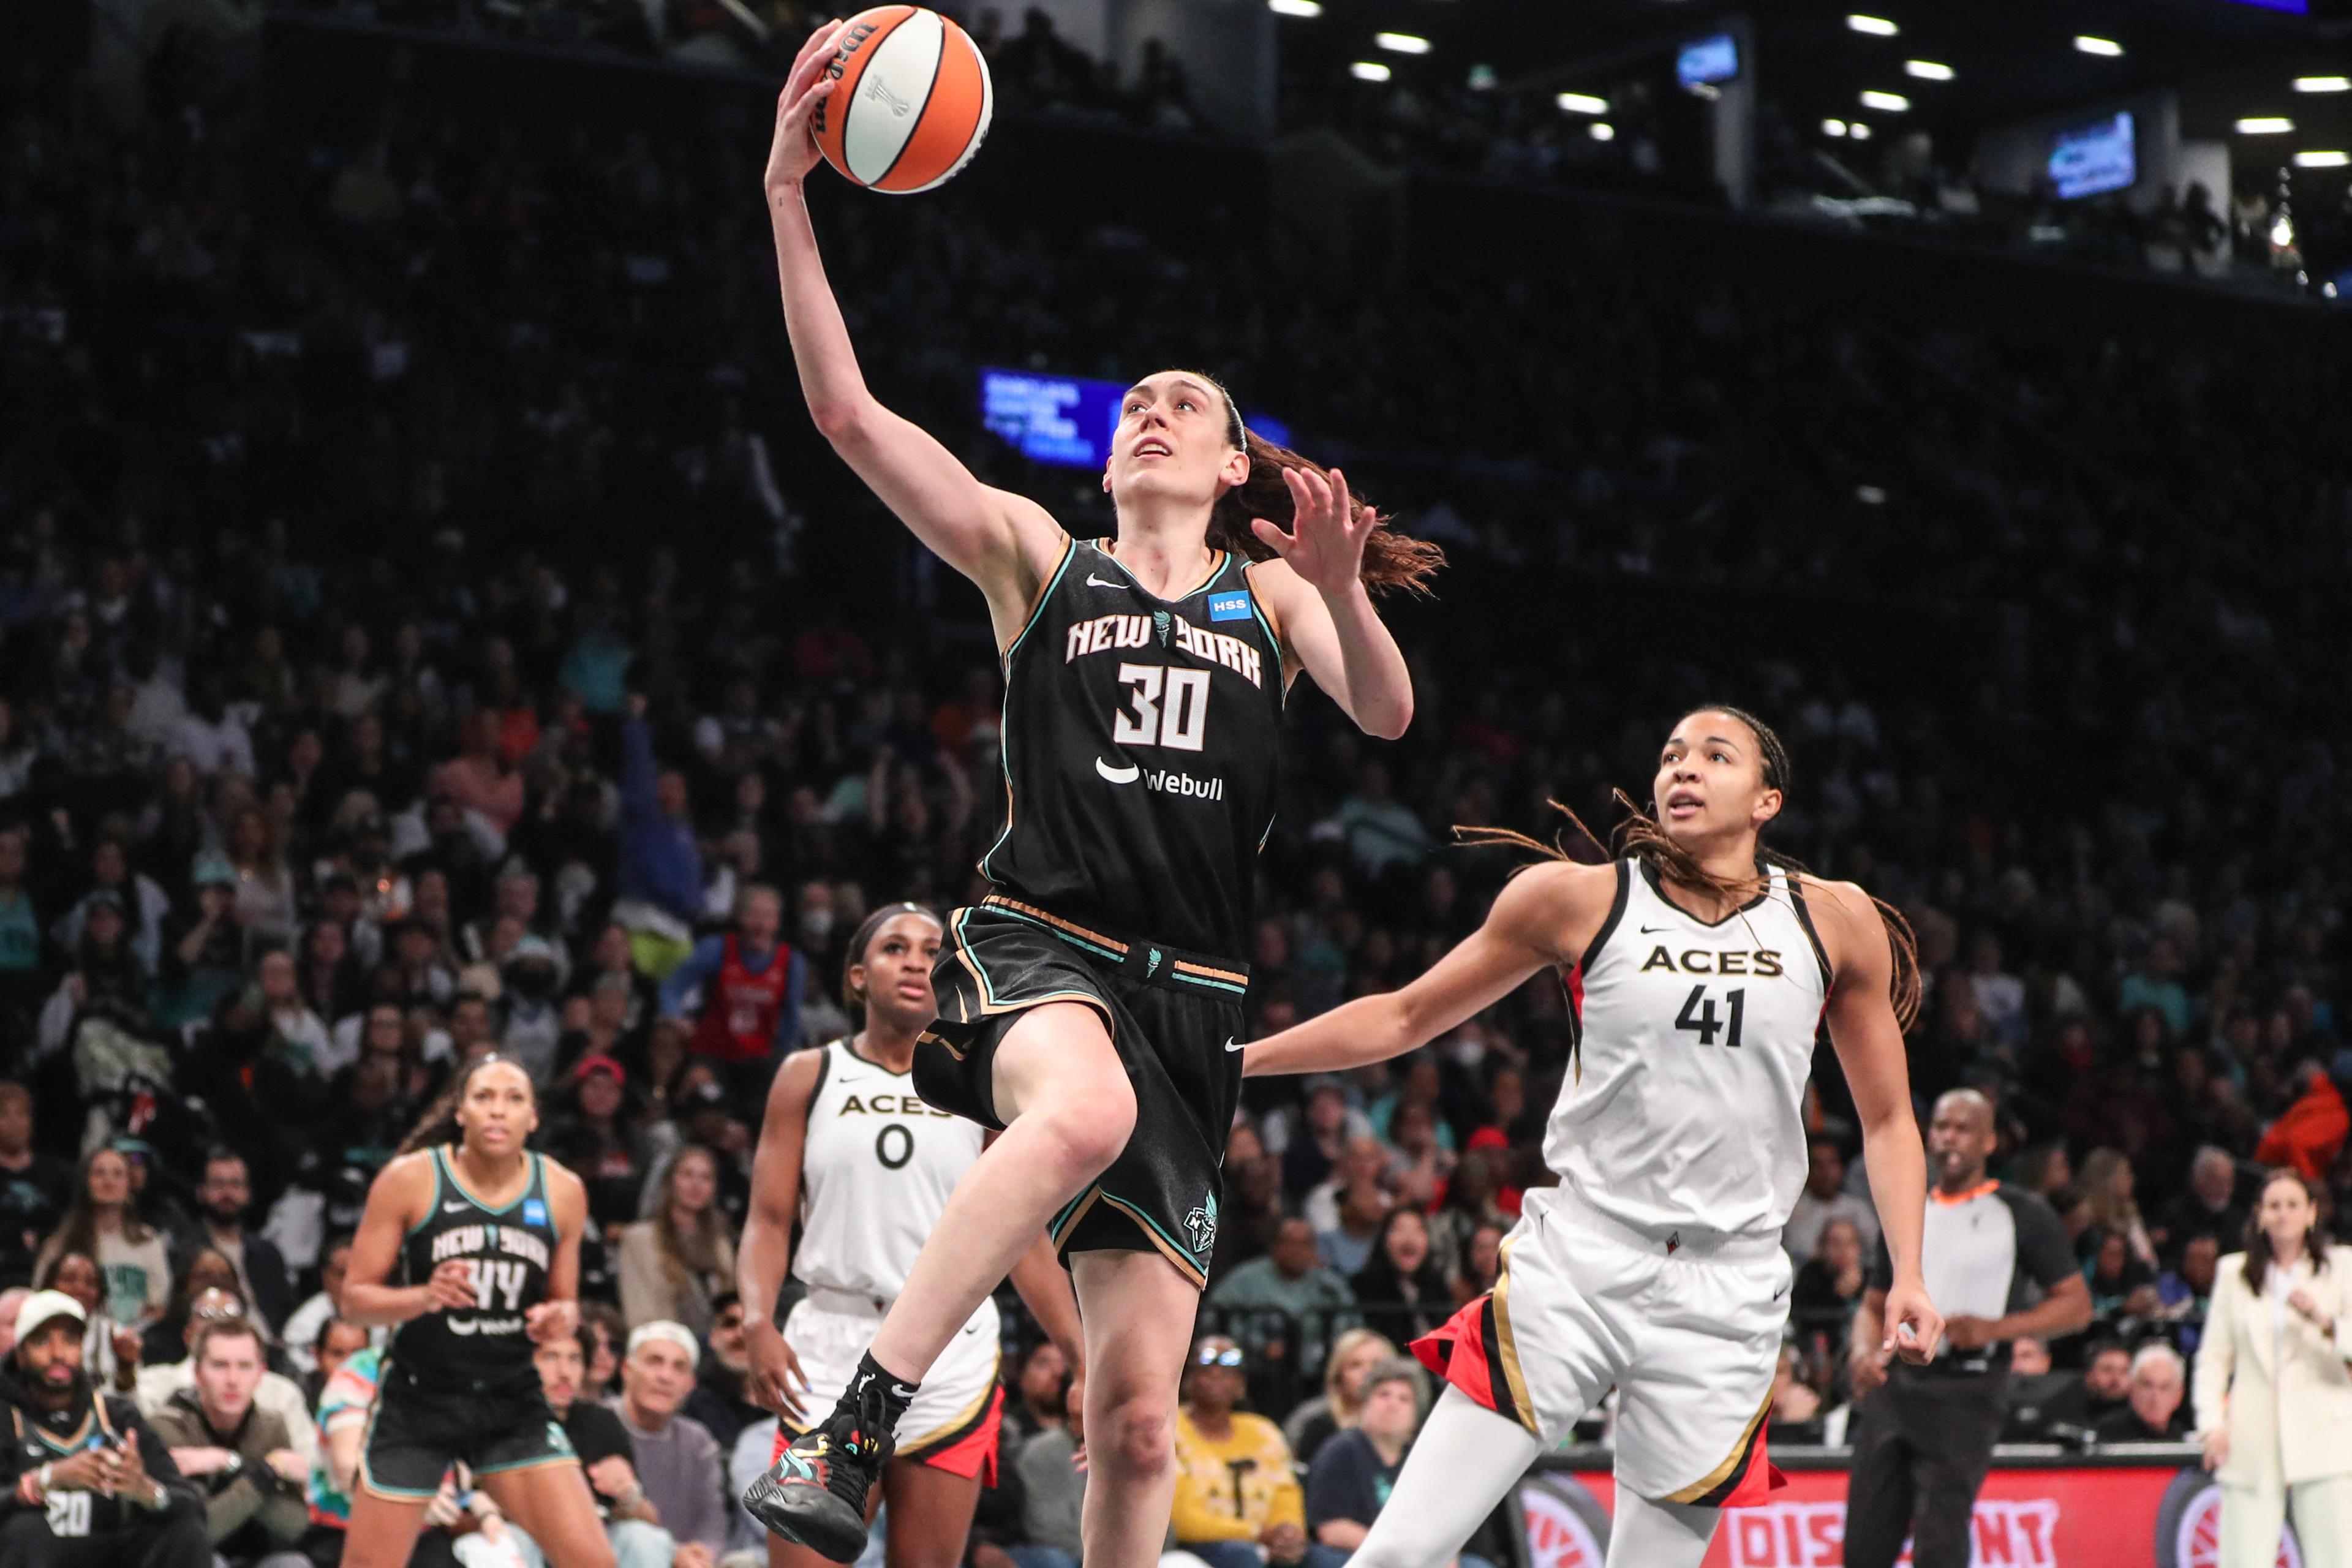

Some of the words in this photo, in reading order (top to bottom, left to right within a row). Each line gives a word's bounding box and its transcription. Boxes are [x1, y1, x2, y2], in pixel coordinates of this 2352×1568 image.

[1213, 599, 1246, 612] HSS
[1066, 614, 1152, 665] NEW
[1174, 613, 1262, 690] YORK
[1113, 662, 1212, 752] 30
[1143, 769, 1223, 801] Webull
[1640, 945, 1784, 977] ACES
[1675, 984, 1745, 1047] 41
[839, 1095, 953, 1118] ACE
[1727, 1501, 2058, 1568] DISNT
